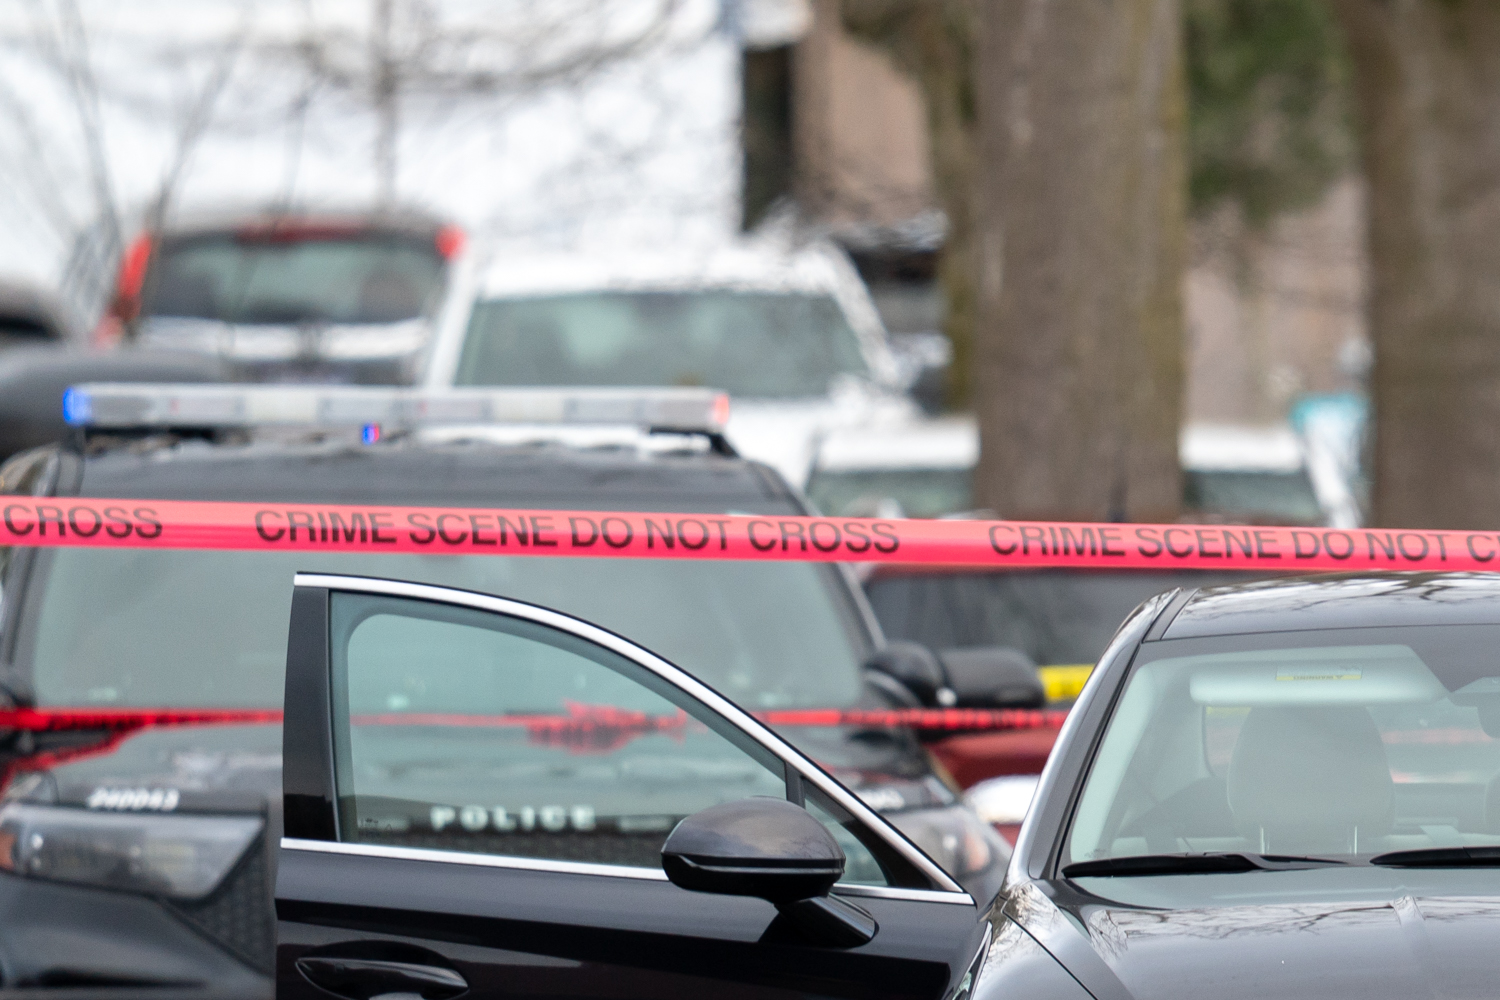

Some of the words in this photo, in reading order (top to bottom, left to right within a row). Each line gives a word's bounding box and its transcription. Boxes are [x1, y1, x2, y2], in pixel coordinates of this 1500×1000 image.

[3, 504, 163, 540] CROSS
[255, 509, 397, 545] CRIME
[409, 513, 558, 547] SCENE
[569, 516, 634, 549] DO
[645, 518, 734, 551] NOT
[748, 520, 900, 553] CROSS
[989, 524, 1126, 558] CRIME
[1134, 527, 1282, 560] SCENE
[1292, 531, 1355, 560] DO
[1366, 532, 1449, 562] NOT
[430, 805, 597, 833] POLICE
